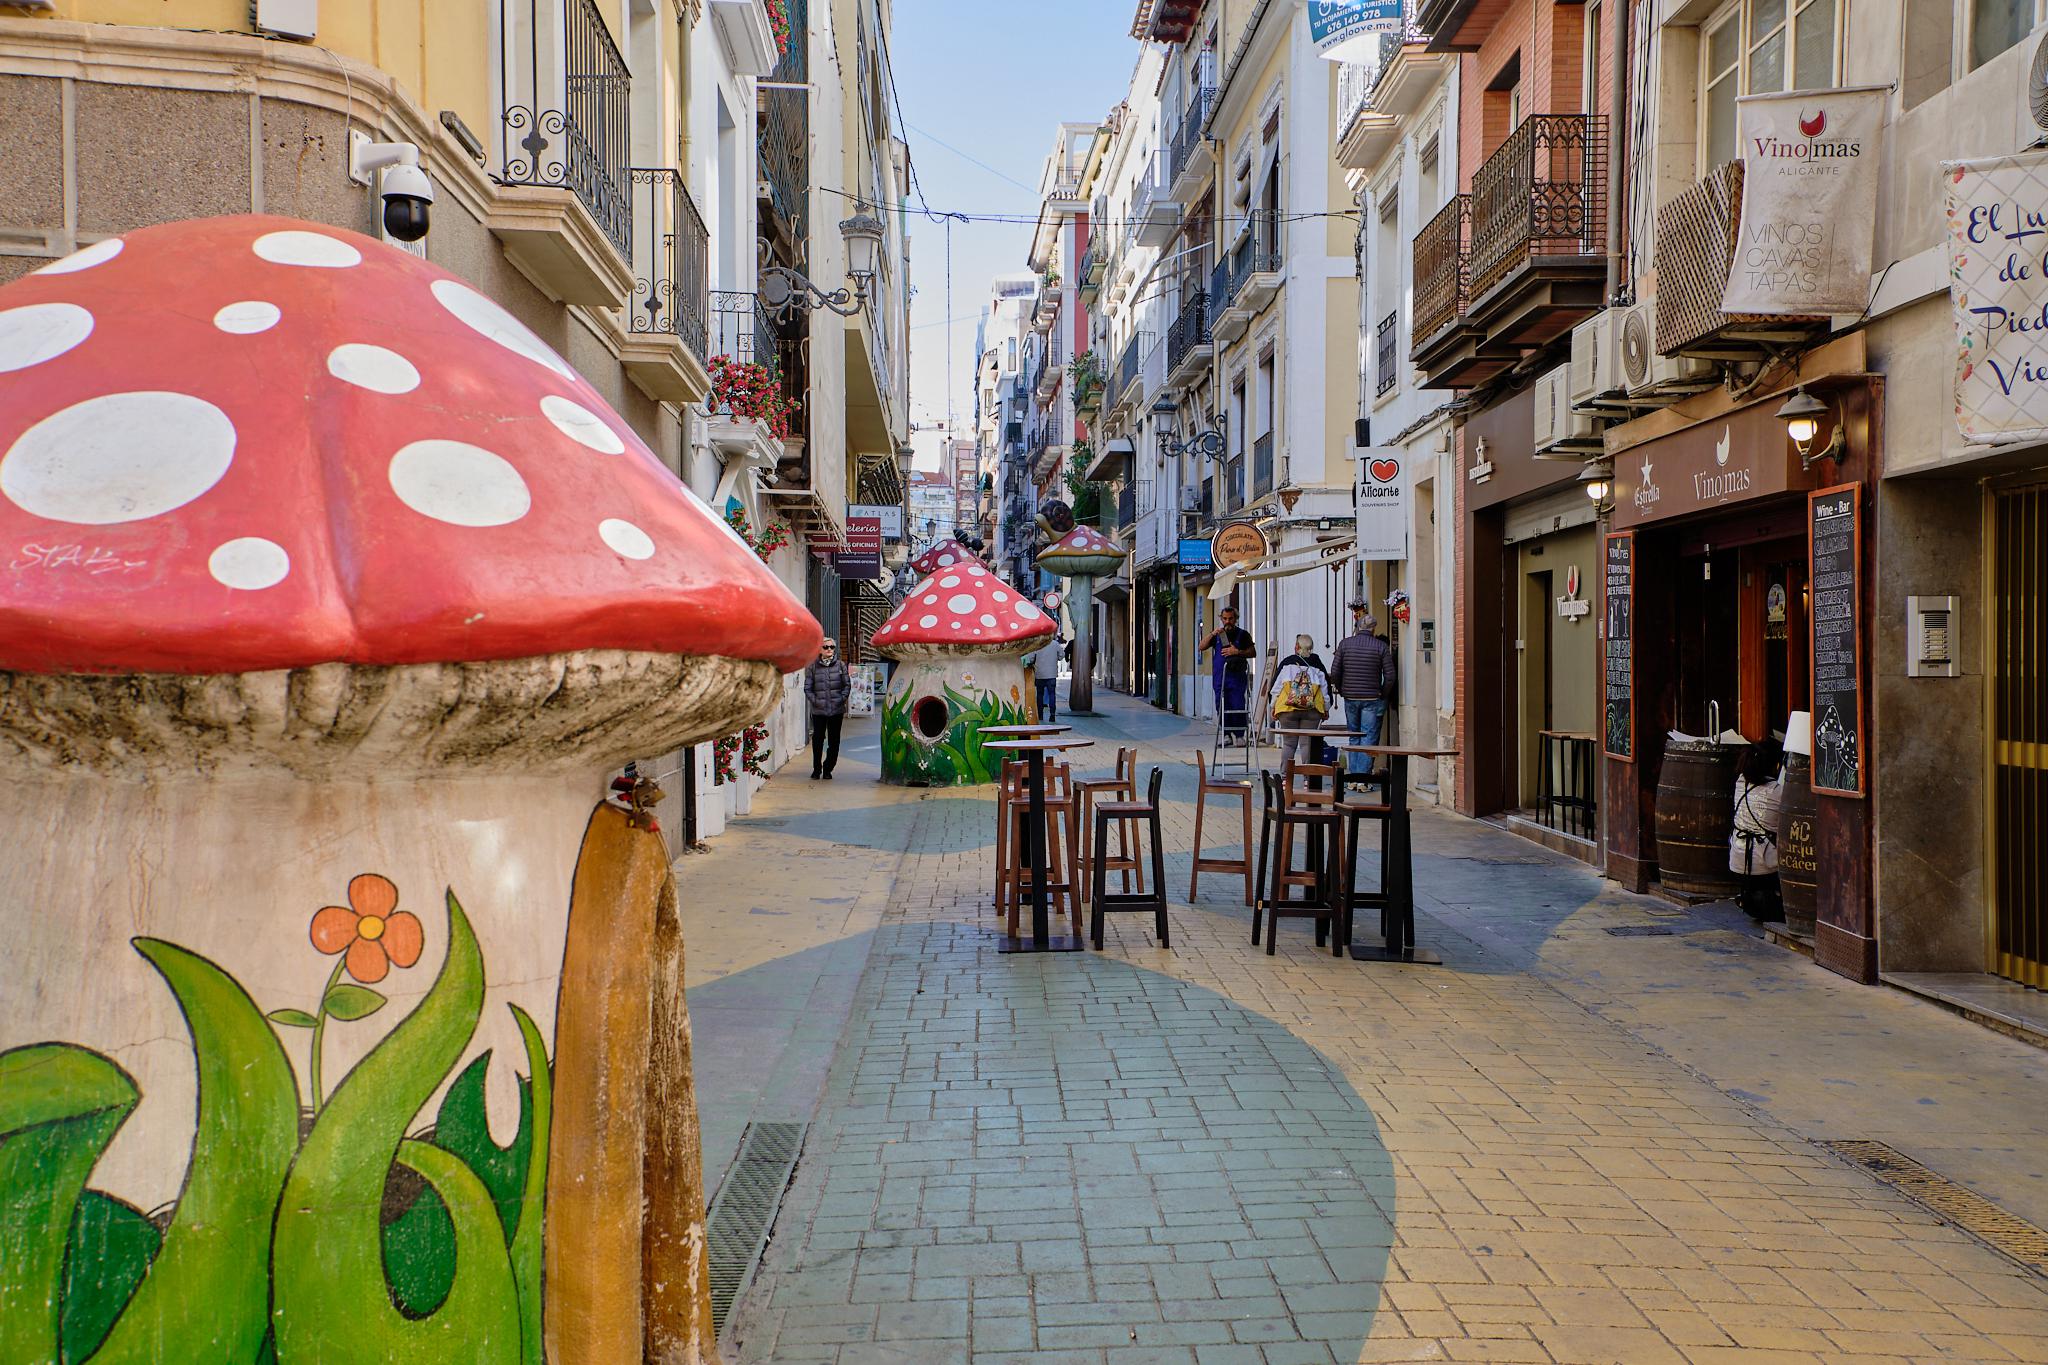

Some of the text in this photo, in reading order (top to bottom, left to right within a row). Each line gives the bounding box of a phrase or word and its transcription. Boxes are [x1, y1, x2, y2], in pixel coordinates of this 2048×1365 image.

[1314, 21, 1321, 29] TU
[1322, 4, 1361, 24] ALOJAMIENTO
[1327, 9, 1381, 34] 676 149 978
[1321, 22, 1393, 49] www.gloove.me
[1778, 166, 1839, 176] ALICANTE
[1749, 223, 1824, 245] VINOS
[1967, 203, 2002, 244] El
[1746, 247, 1821, 269] CAVAS
[1999, 253, 2033, 282] de
[1745, 271, 1817, 293] TAPAS
[1360, 457, 1371, 485] I
[1361, 486, 1399, 498] Alicante
[1816, 504, 1834, 518] Wine
[1838, 500, 1850, 513] Bar
